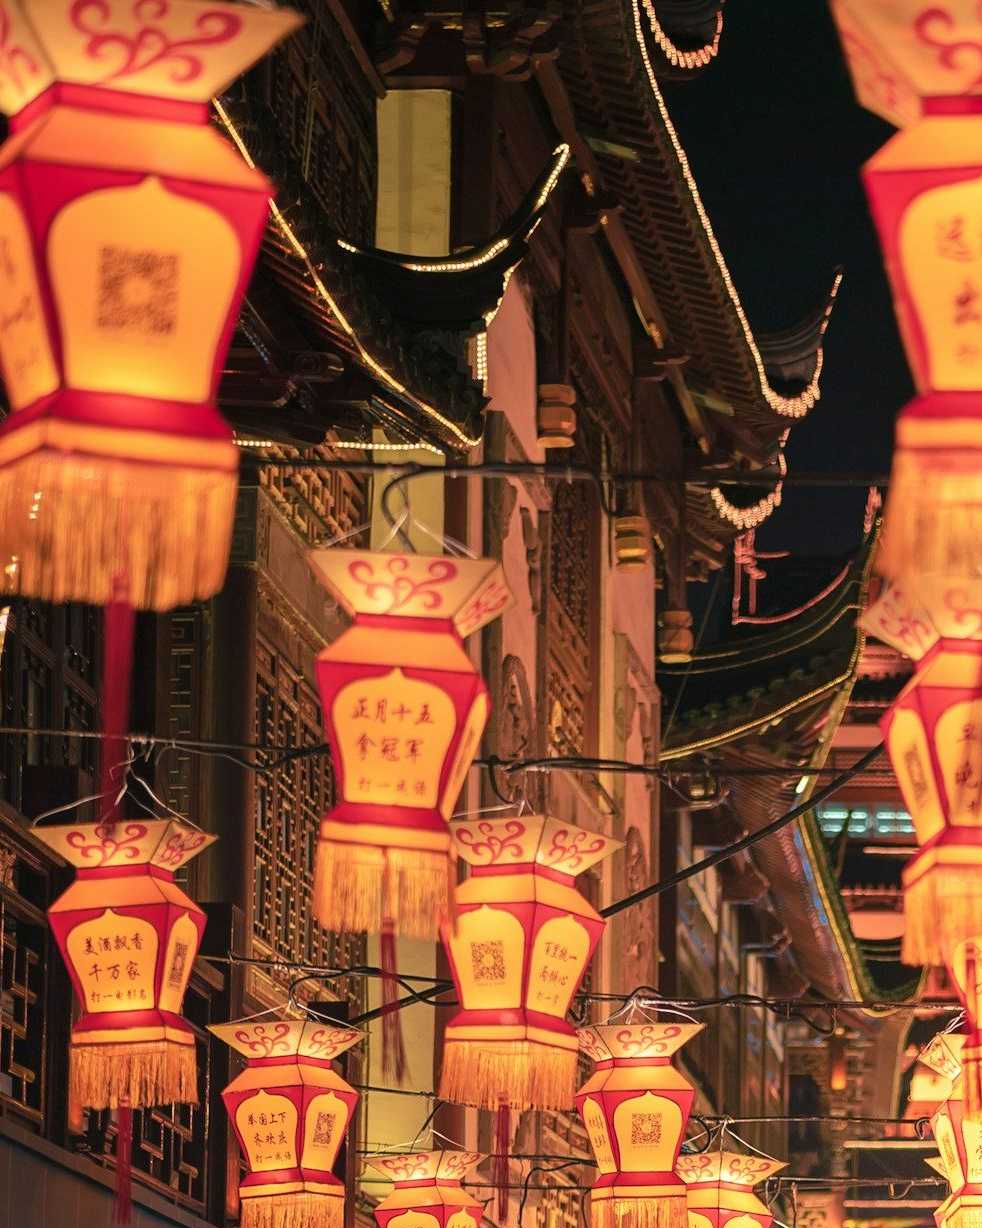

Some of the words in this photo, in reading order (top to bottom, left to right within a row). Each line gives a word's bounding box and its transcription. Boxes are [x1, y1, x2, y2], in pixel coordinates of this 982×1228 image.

[352, 698, 434, 724] 正月十五
[84, 932, 144, 956] 美酒飘香
[88, 960, 141, 982] 千万家
